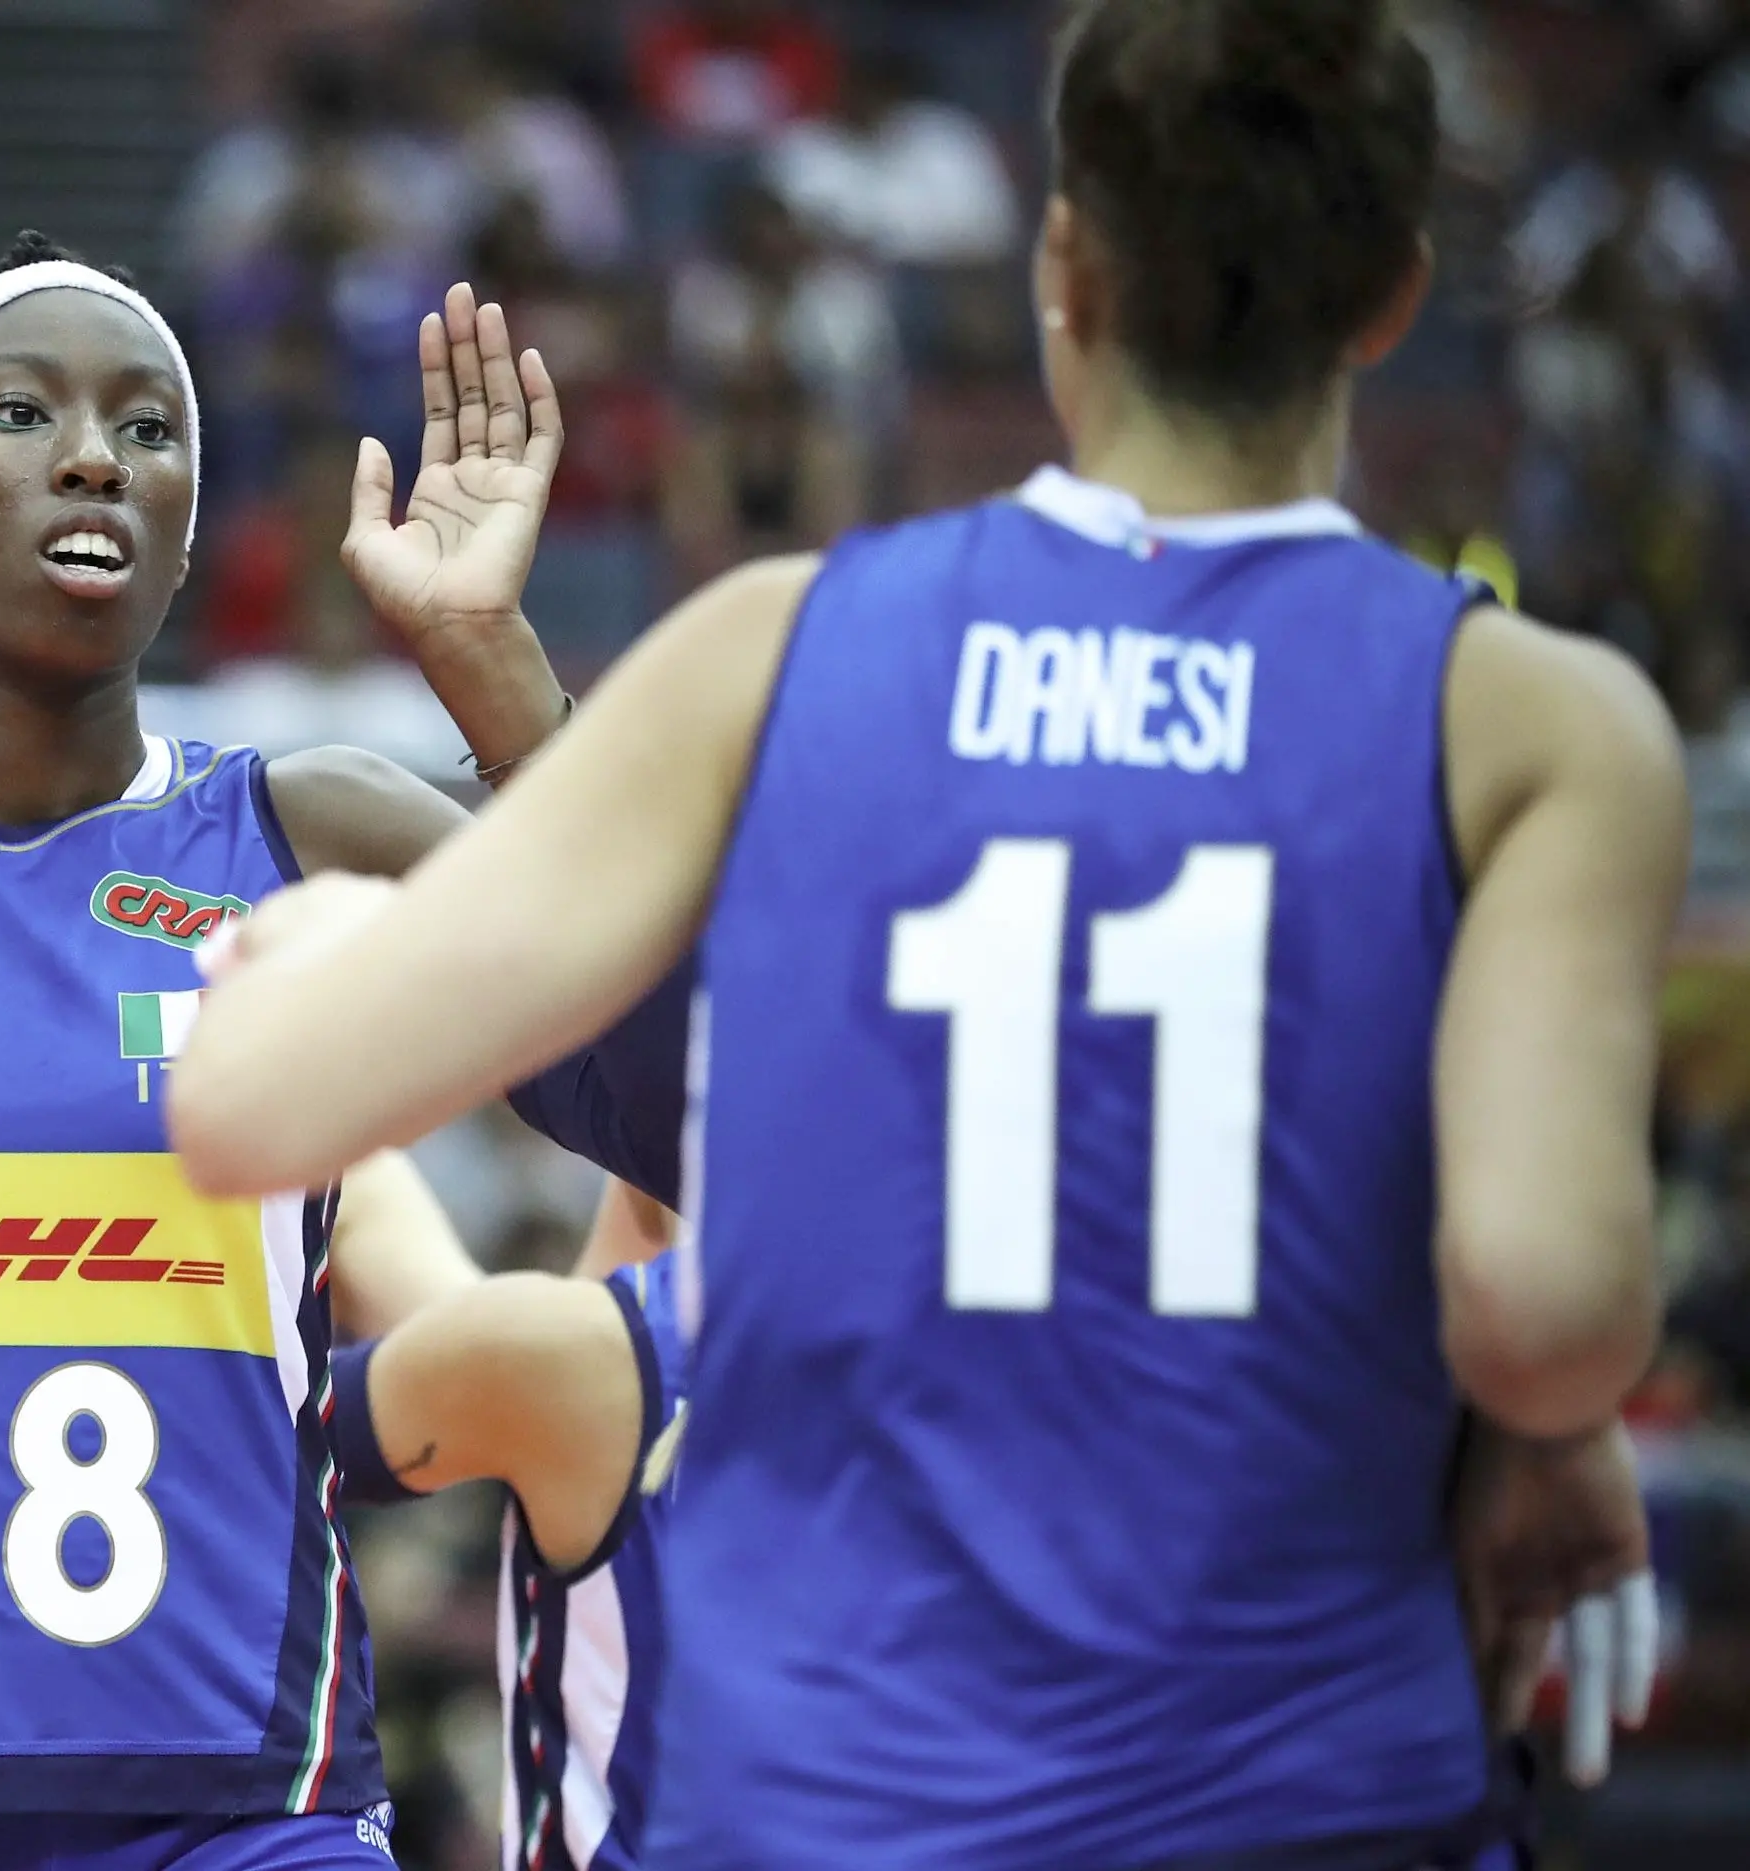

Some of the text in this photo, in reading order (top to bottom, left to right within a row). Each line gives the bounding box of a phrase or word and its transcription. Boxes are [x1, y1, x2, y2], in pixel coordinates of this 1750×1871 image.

[949, 620, 1255, 774] DANESI
[103, 882, 240, 942] CRA
[885, 836, 1275, 1319] 11
[356, 1817, 395, 1862] erre
